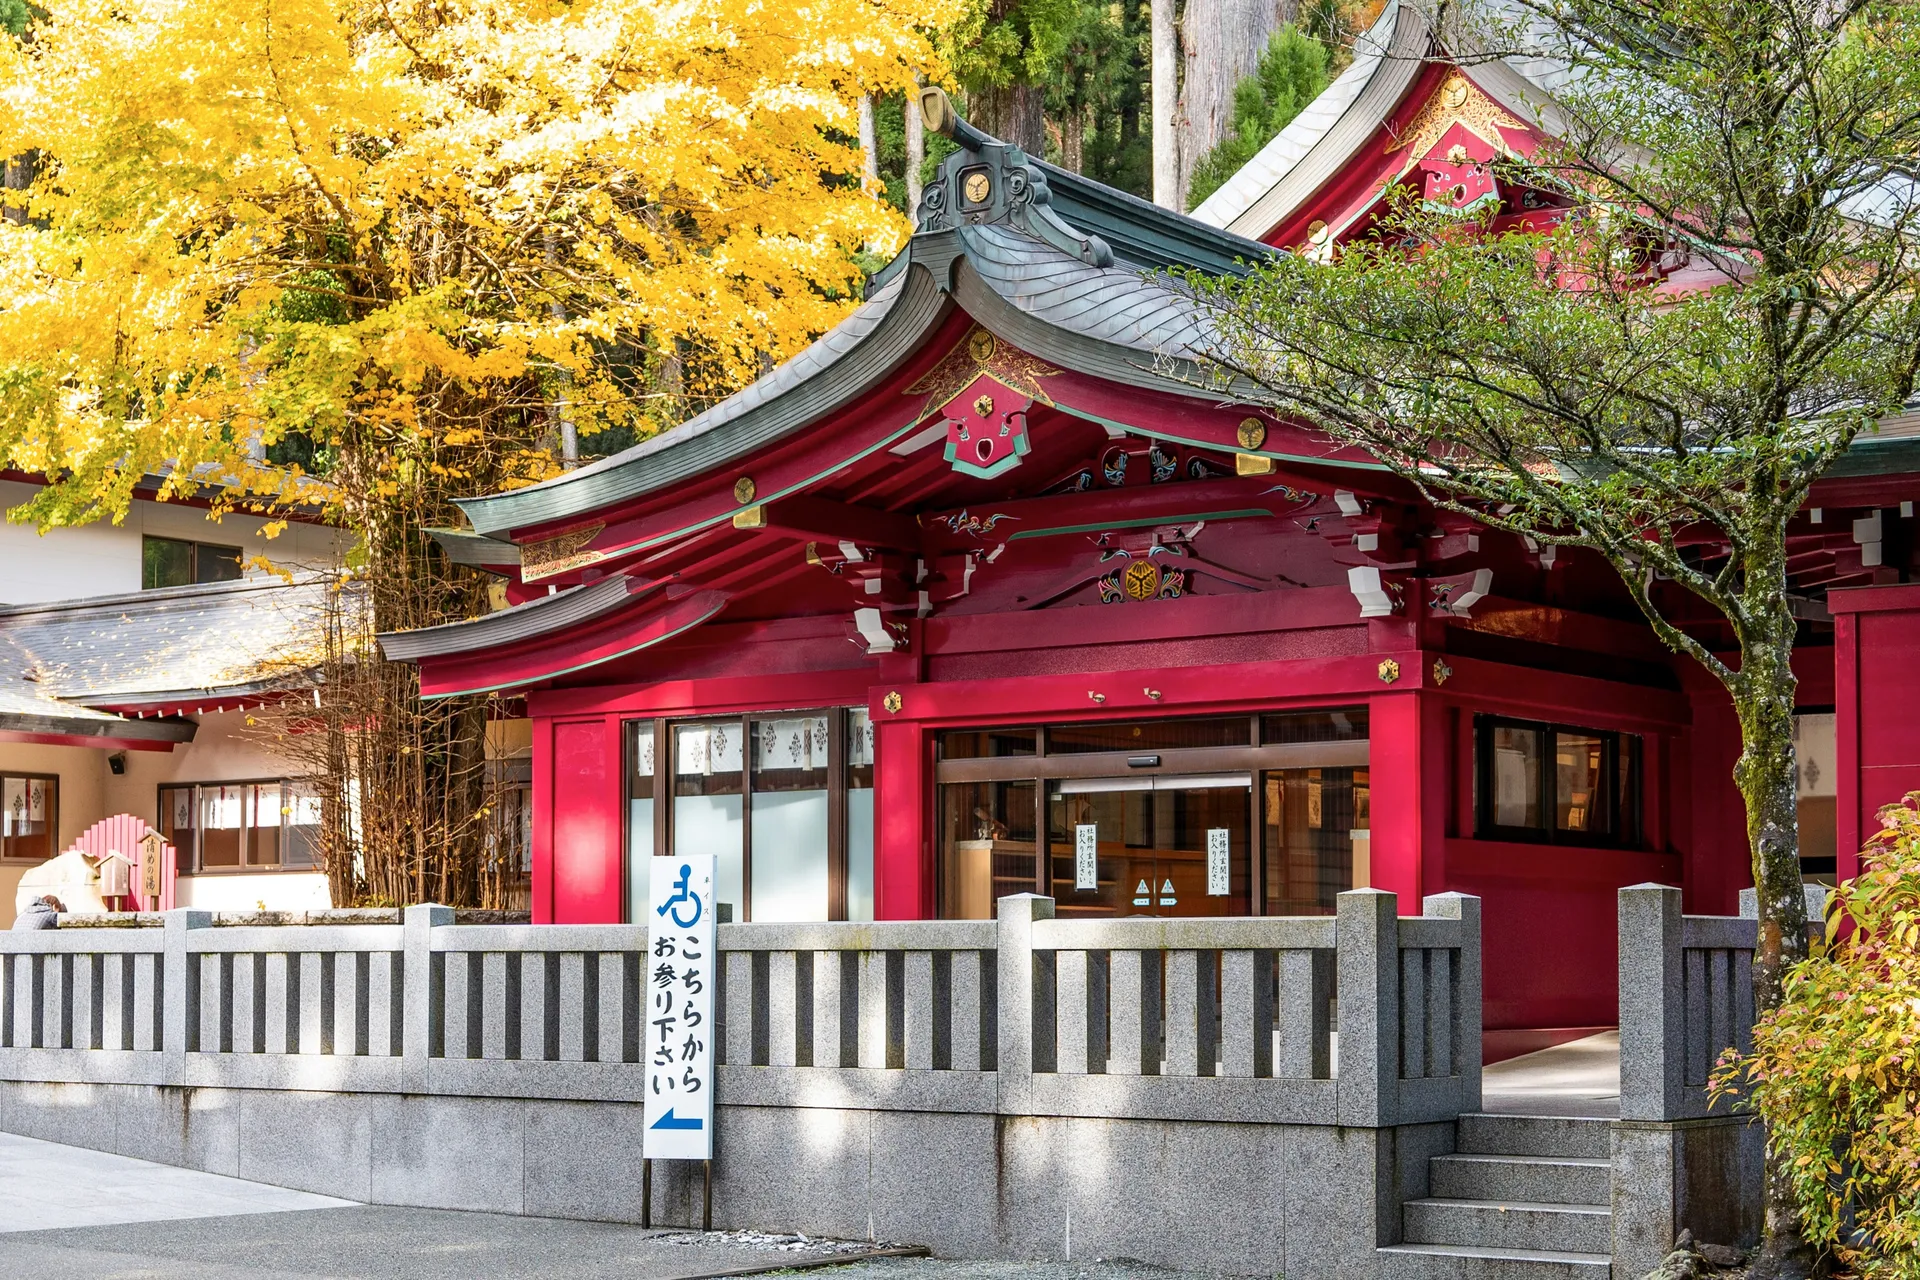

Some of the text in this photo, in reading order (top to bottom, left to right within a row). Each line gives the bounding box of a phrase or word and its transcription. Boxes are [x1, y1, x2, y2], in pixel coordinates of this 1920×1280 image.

[146, 838, 156, 891] 清めの湯
[1219, 831, 1227, 891] 社務所玄関から
[652, 936, 677, 1095] お参り下さい
[681, 935, 704, 1093] こちらから
